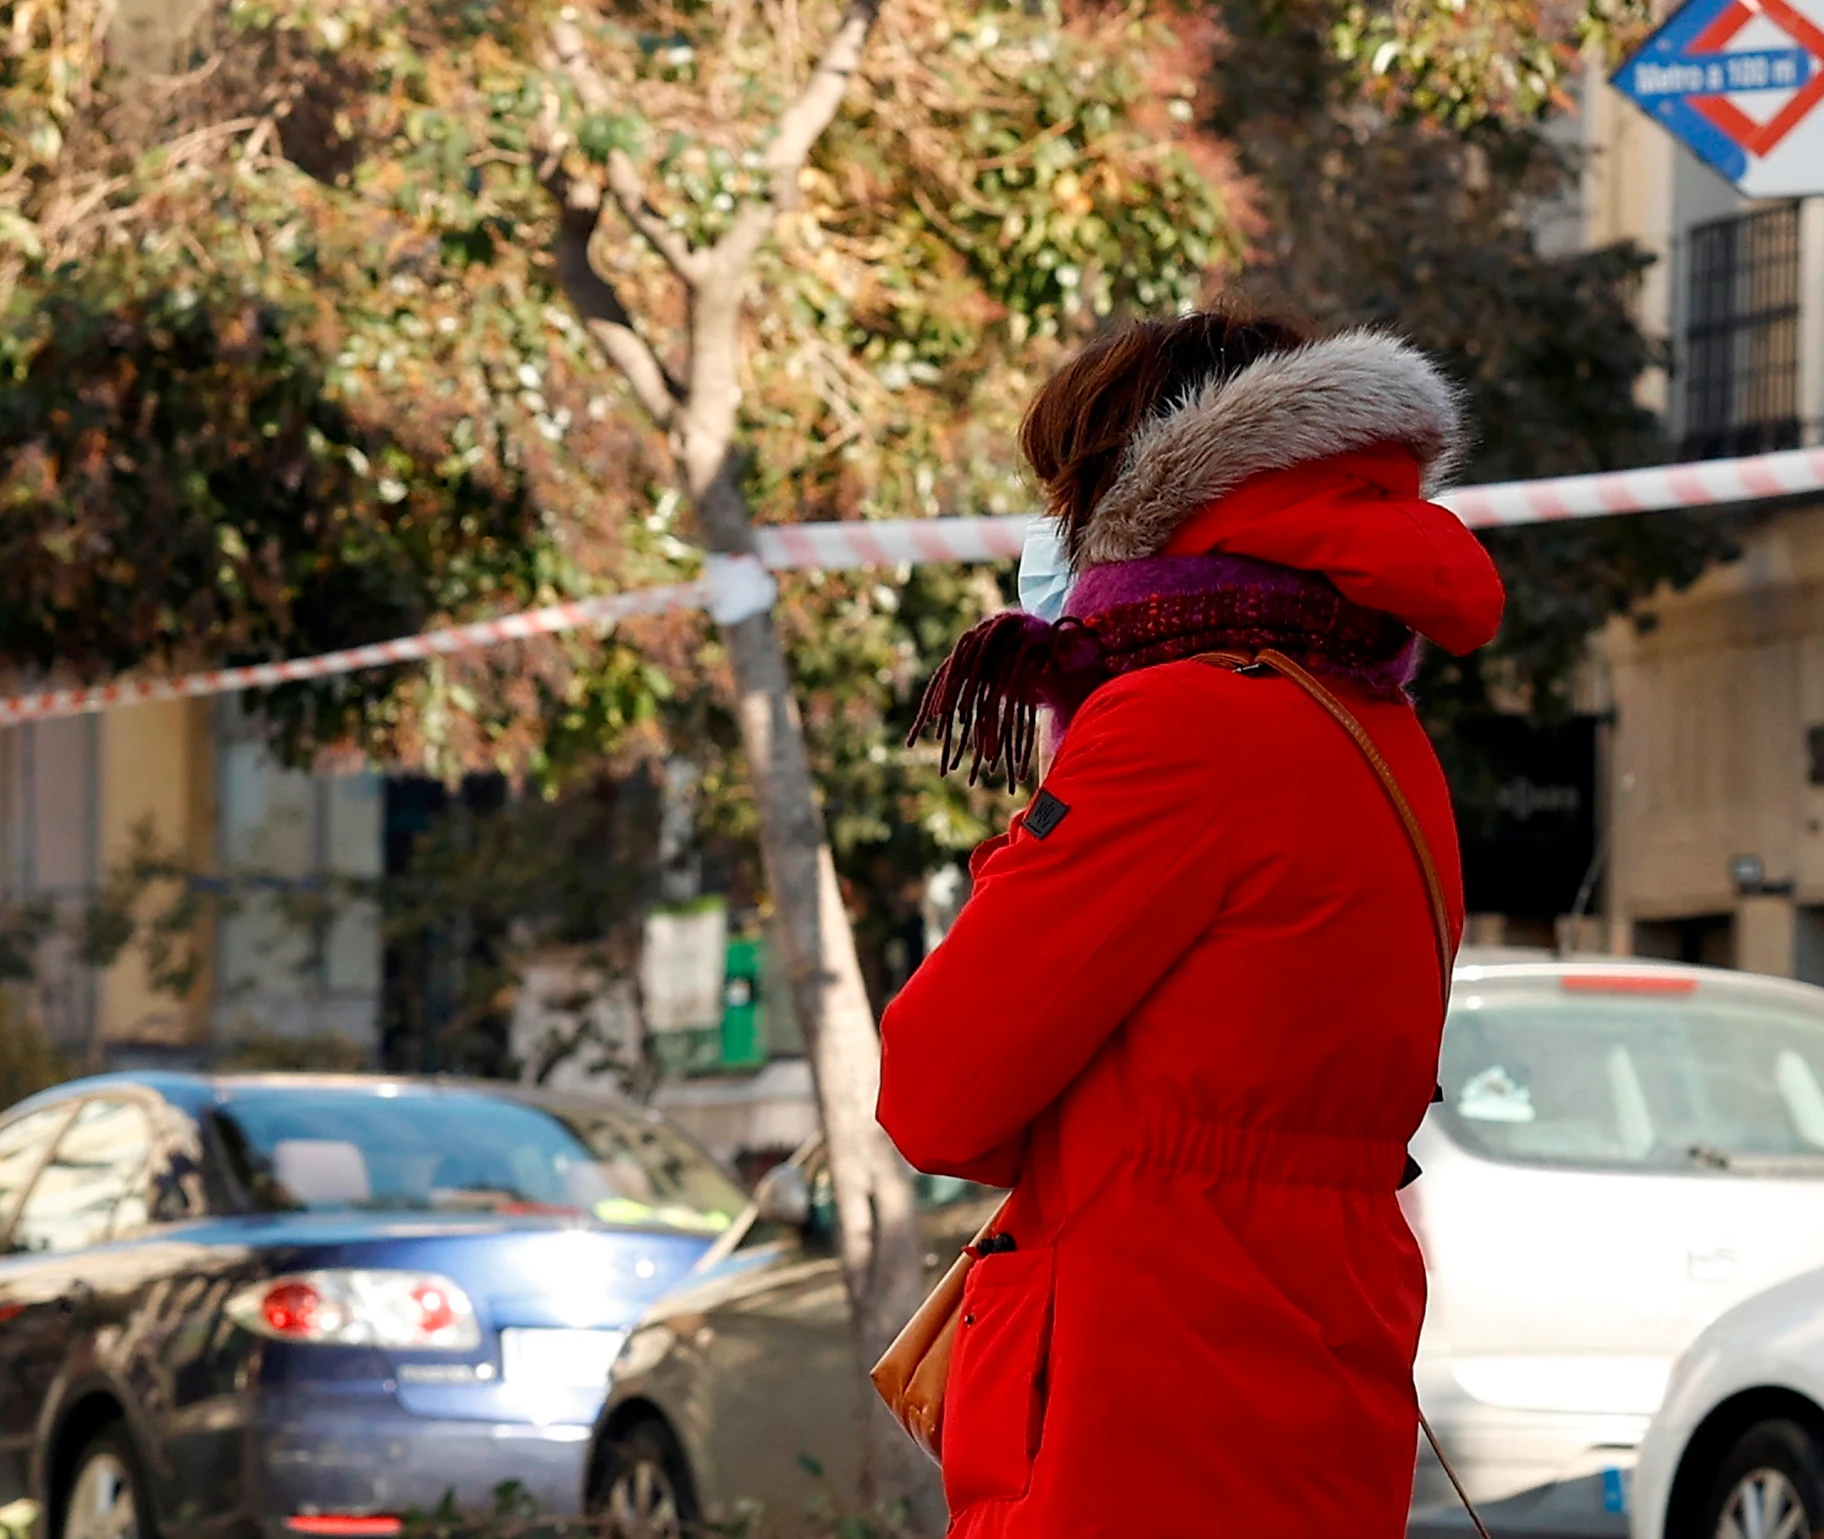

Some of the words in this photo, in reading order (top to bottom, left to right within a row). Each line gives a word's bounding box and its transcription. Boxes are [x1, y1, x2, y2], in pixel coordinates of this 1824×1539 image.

[1634, 62, 1704, 95] Metro
[1706, 64, 1723, 91] a
[1728, 56, 1769, 87] 100
[1771, 58, 1796, 83] m
